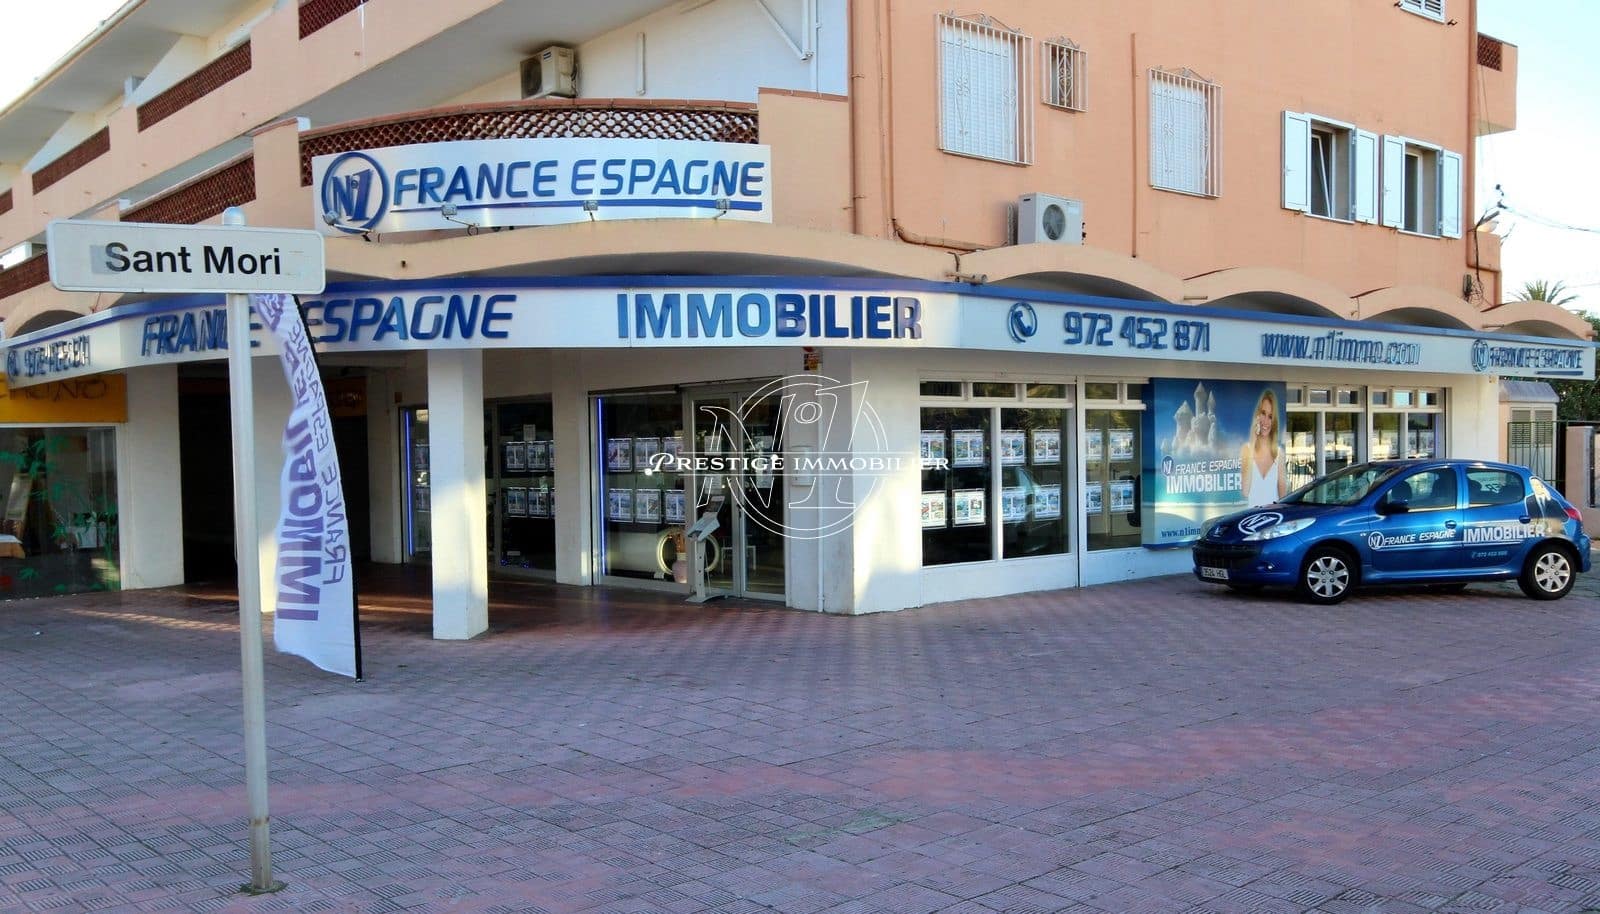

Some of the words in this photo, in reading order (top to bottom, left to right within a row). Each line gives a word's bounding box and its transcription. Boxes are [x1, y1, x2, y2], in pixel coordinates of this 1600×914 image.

[392, 160, 559, 206] FRANCE
[570, 158, 765, 198] ESPAGNE
[104, 242, 192, 273] Sant
[203, 245, 281, 275] Mori
[302, 294, 518, 343] ESPAGNE
[616, 292, 922, 340] IMMOBILIER
[1063, 311, 1114, 347] 972
[1119, 315, 1169, 350] 452
[1173, 319, 1210, 352] 871
[1175, 461, 1207, 475] FRANCE
[1209, 457, 1242, 472] ESPAGNE
[1166, 472, 1242, 494] IMMOBILIER
[1383, 533, 1416, 545] FRANCE
[1419, 528, 1457, 541] ESPAGNE
[1463, 525, 1545, 542] IMMOBILIER
